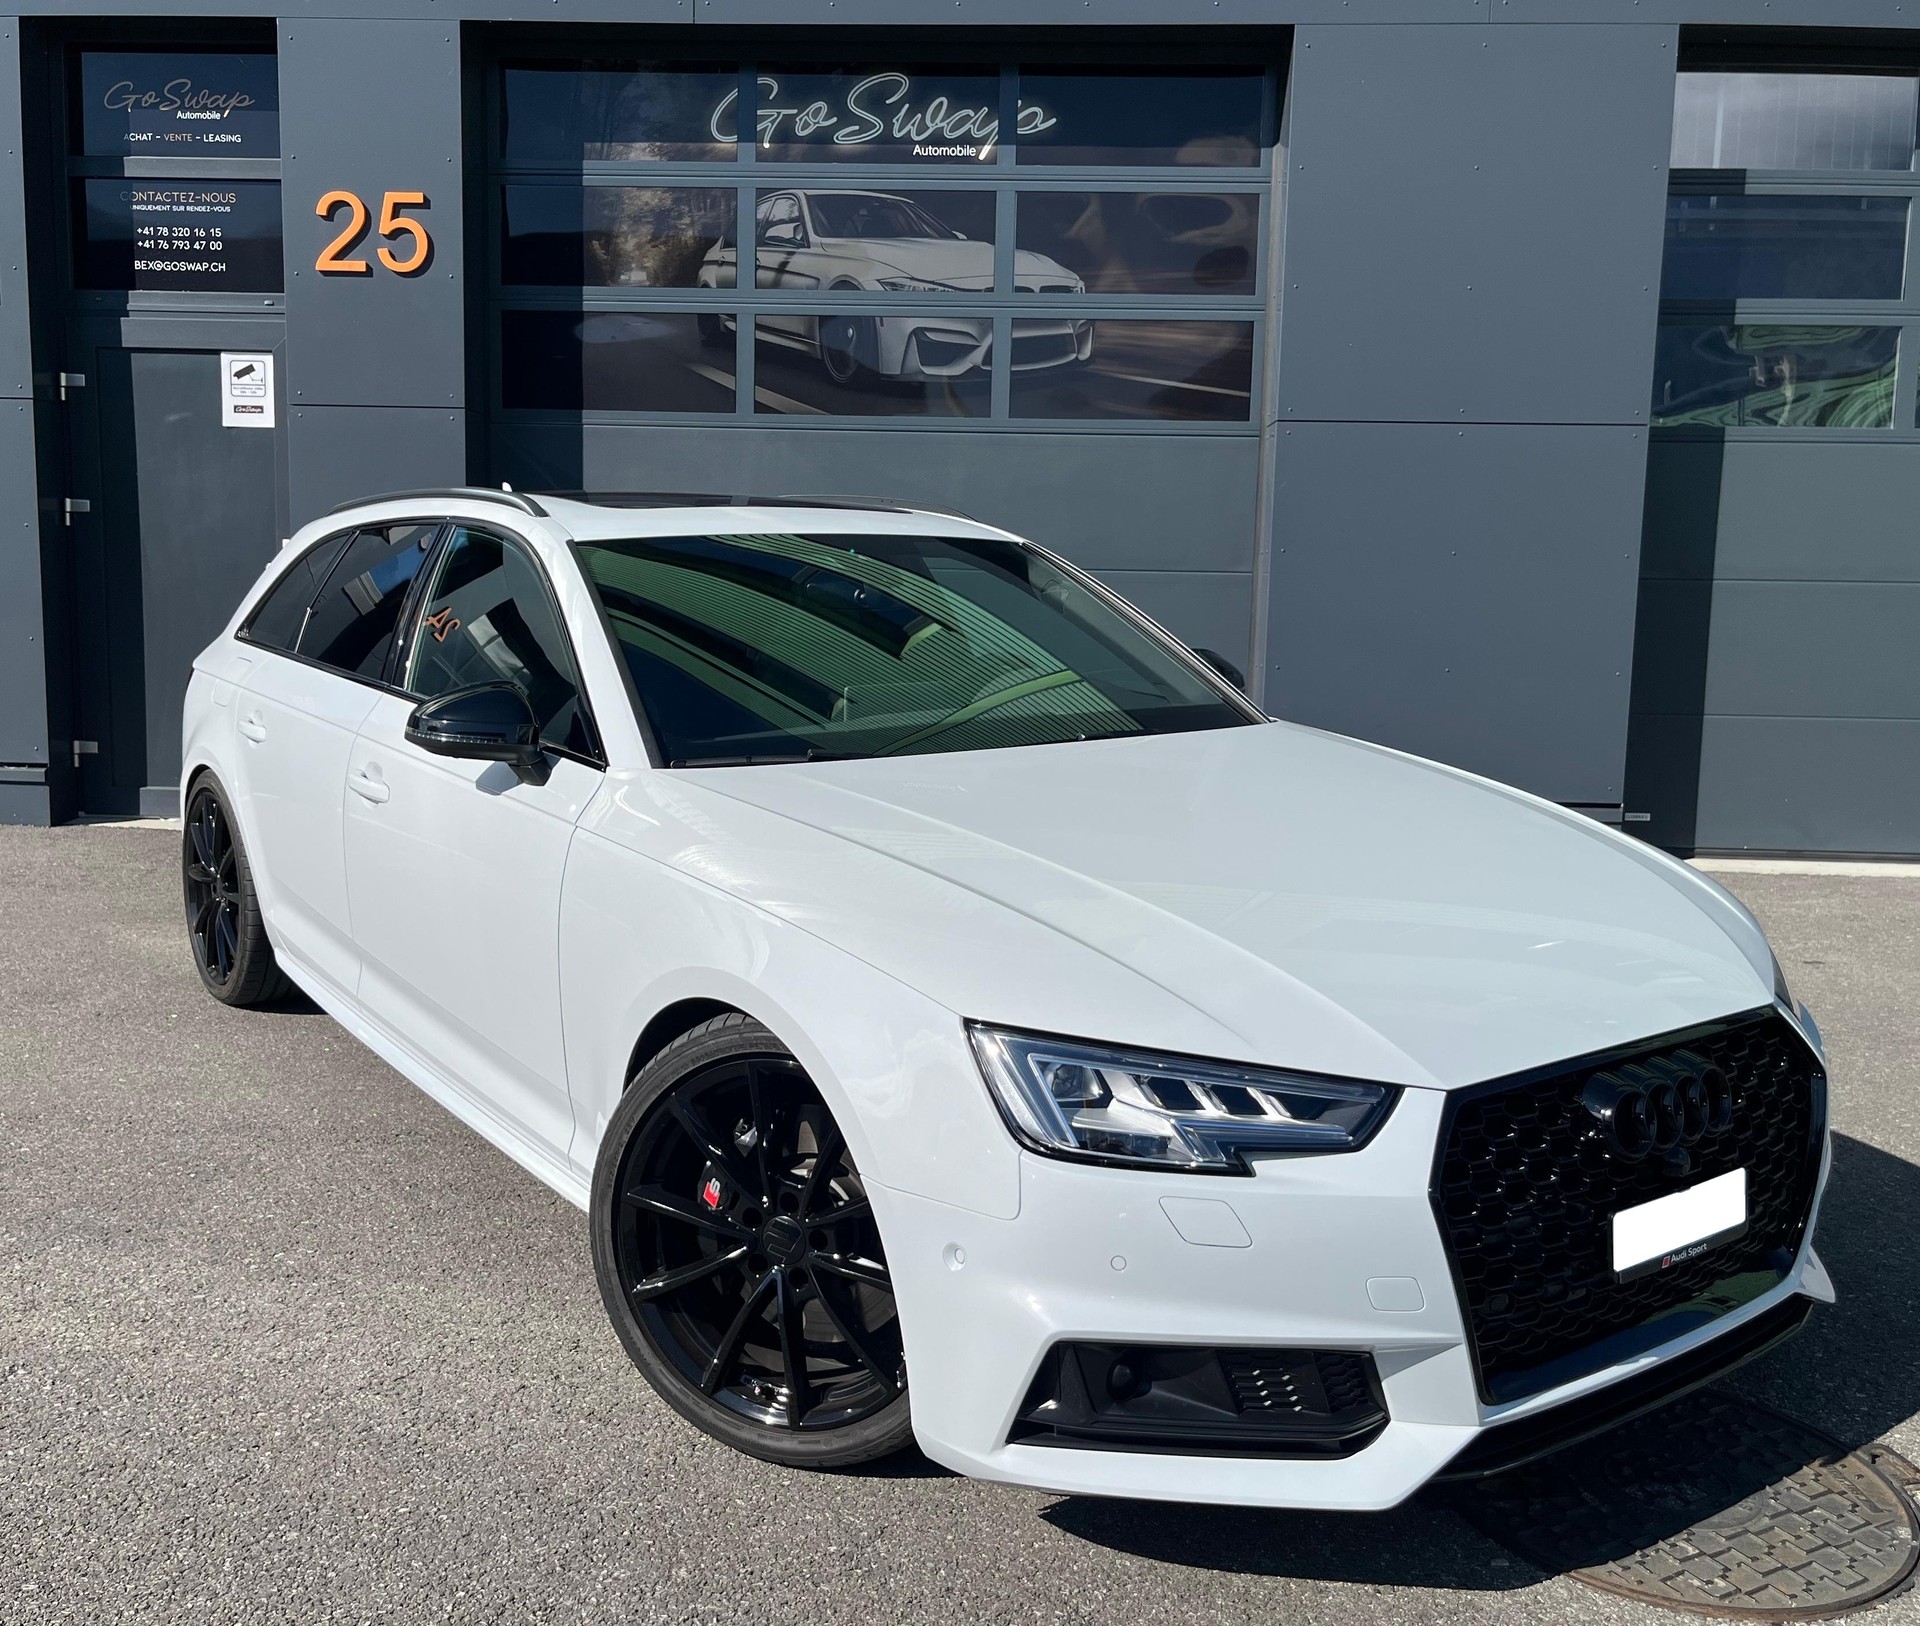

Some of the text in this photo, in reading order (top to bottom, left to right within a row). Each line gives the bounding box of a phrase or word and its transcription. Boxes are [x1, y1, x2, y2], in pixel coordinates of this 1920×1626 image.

[176, 110, 221, 120] Automobile
[123, 132, 153, 142] ACHAT
[163, 133, 193, 142] VENTE
[203, 133, 242, 143] LEASING
[912, 144, 977, 157] Automobile
[120, 191, 237, 203] CONTACTEZ-NOUS
[136, 227, 222, 238] +41 78 320 16 15
[315, 190, 429, 273] 25
[137, 240, 223, 251] +41 76 793 47 00
[134, 260, 226, 272] BEX@GOSWAP.CH
[1671, 1243, 1708, 1263] Audi Sport
